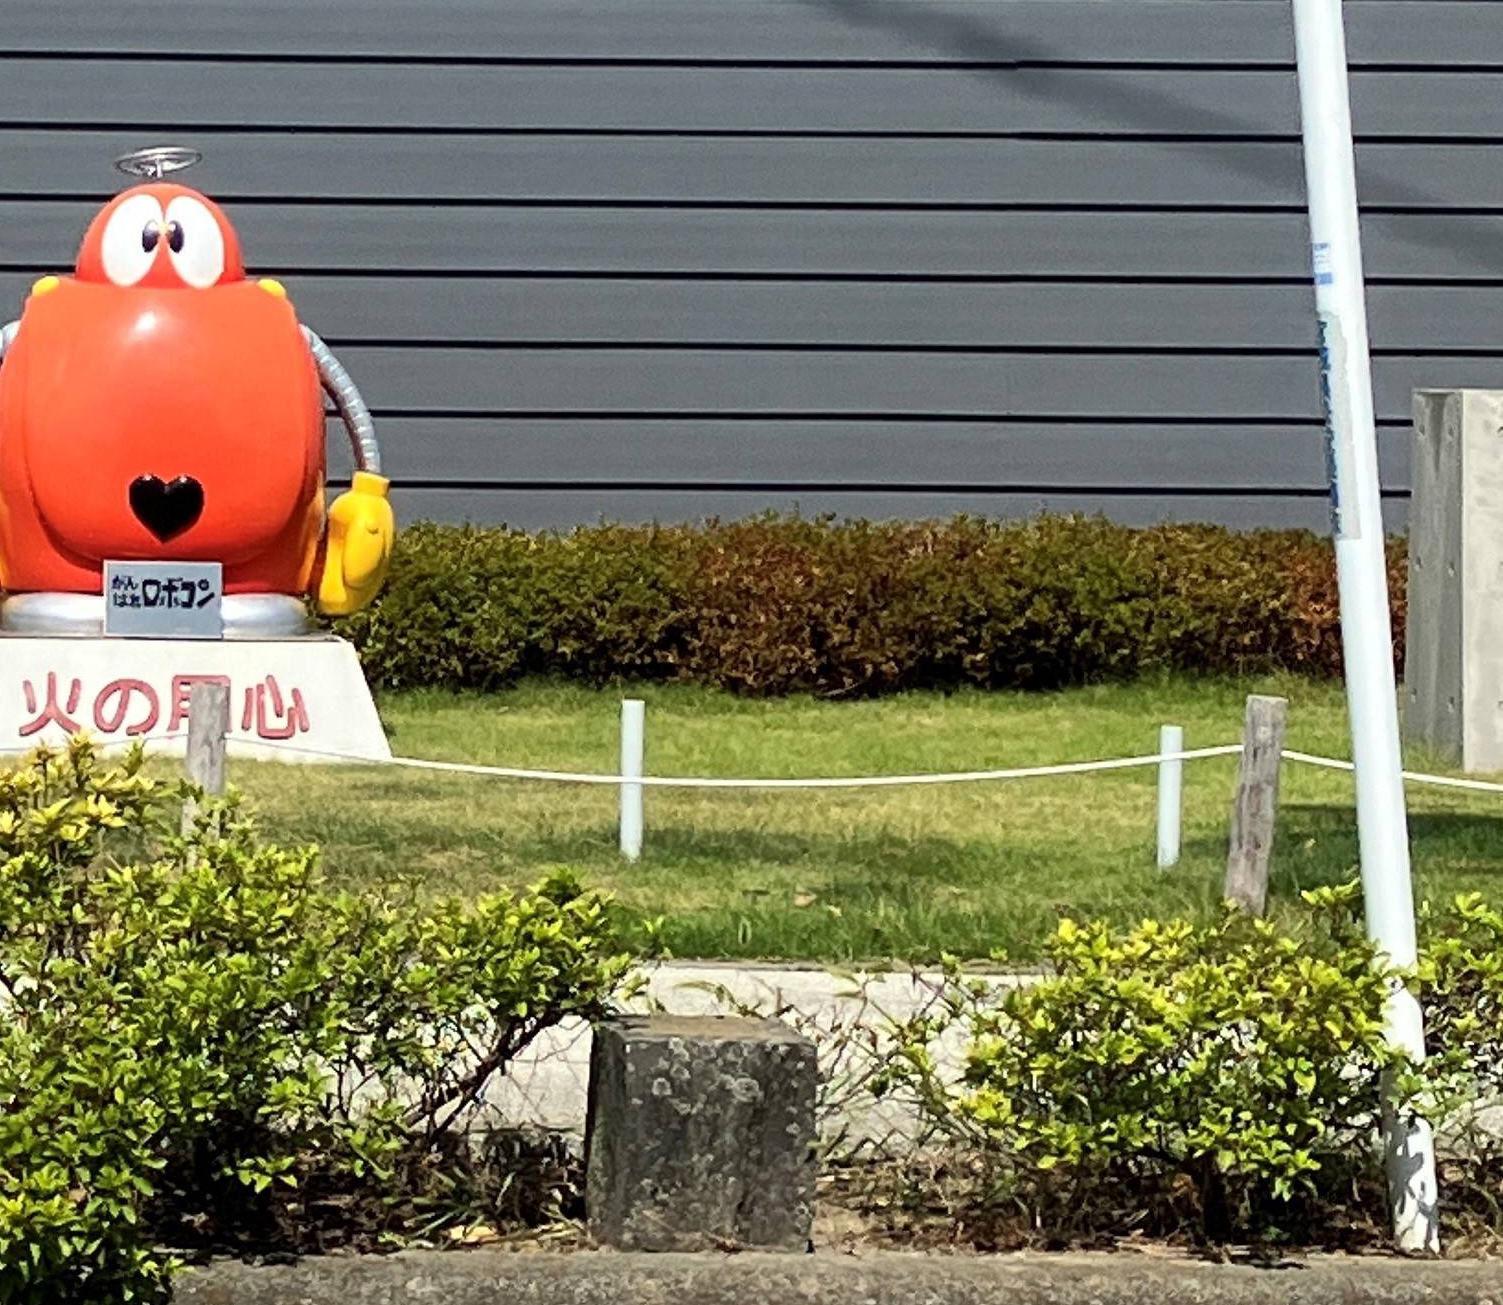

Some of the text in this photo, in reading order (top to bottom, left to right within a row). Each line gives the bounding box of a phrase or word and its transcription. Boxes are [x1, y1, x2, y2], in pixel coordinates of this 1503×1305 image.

[142, 577, 215, 609] ロボコン
[19, 671, 311, 739] 火の用心
